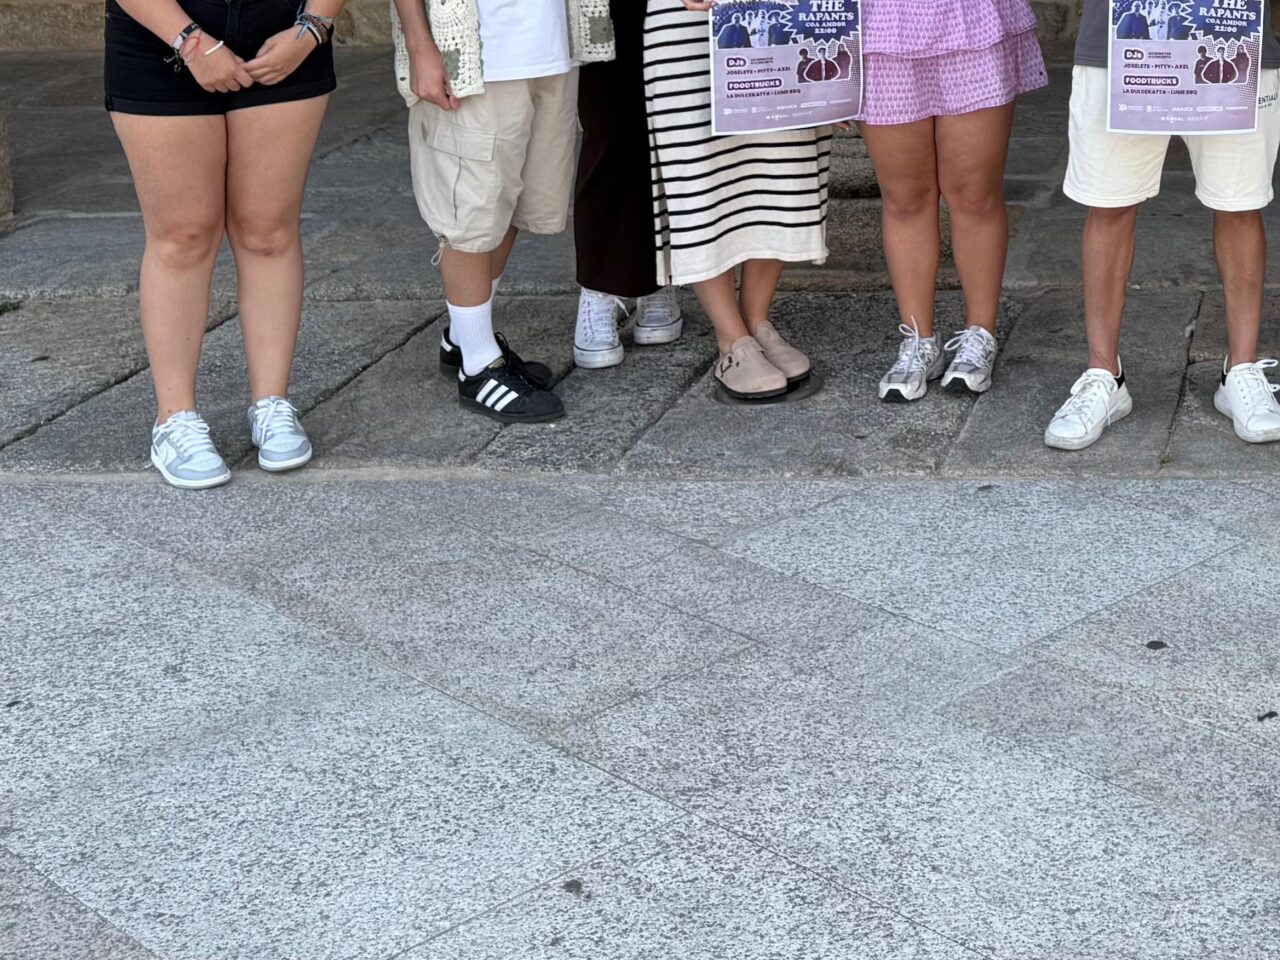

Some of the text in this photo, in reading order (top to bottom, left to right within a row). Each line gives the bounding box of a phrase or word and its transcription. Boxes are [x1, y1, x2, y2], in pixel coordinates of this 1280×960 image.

[809, 0, 845, 12] THE
[798, 12, 855, 21] RAPANTS
[1199, 7, 1257, 21] RAPANTS
[1126, 51, 1142, 59] DJs
[728, 80, 780, 89] FOODTRUCKS
[1125, 77, 1177, 86] FOODTRUCKS
